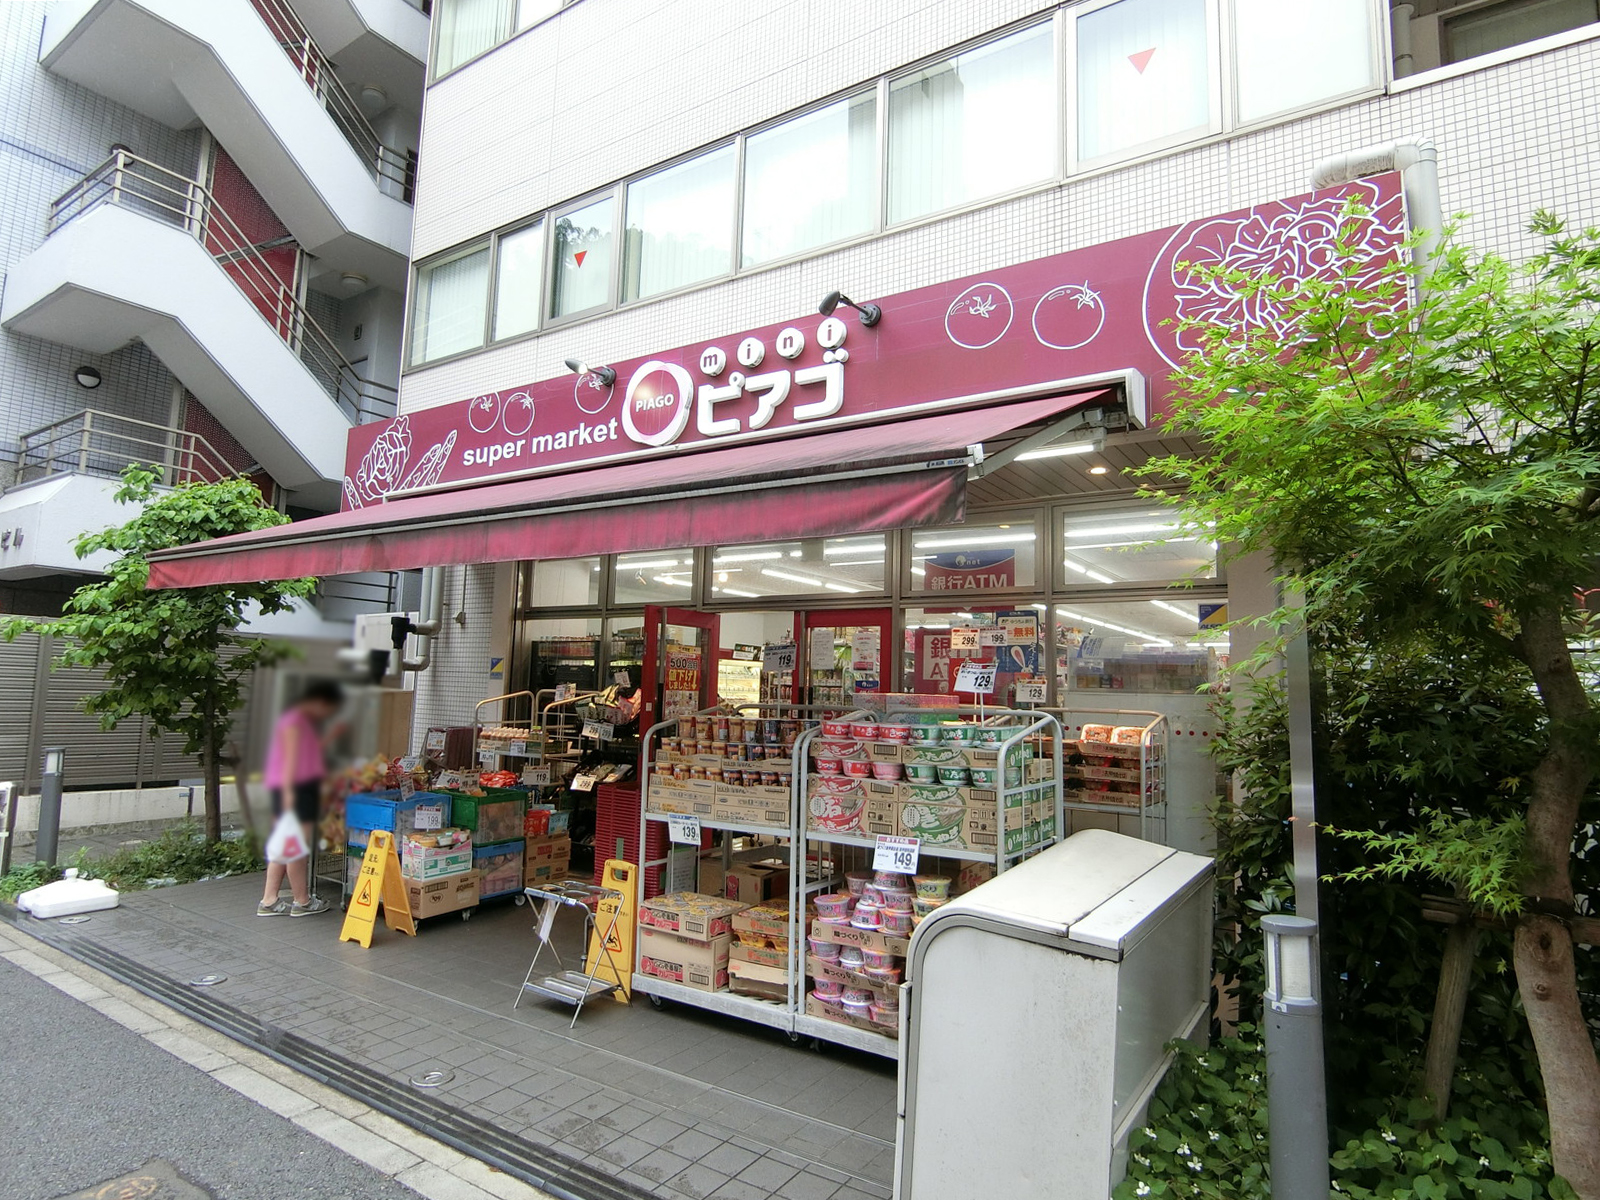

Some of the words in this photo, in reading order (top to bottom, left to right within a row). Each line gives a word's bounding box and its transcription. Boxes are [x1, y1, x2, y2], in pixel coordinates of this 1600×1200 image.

[702, 323, 835, 369] mini
[635, 392, 675, 413] PIAGO
[697, 348, 849, 437] ピアゴ
[463, 439, 526, 467] super
[531, 417, 619, 454] market
[930, 573, 1008, 590] 銀行ATM
[669, 669, 693, 682] 値下げ
